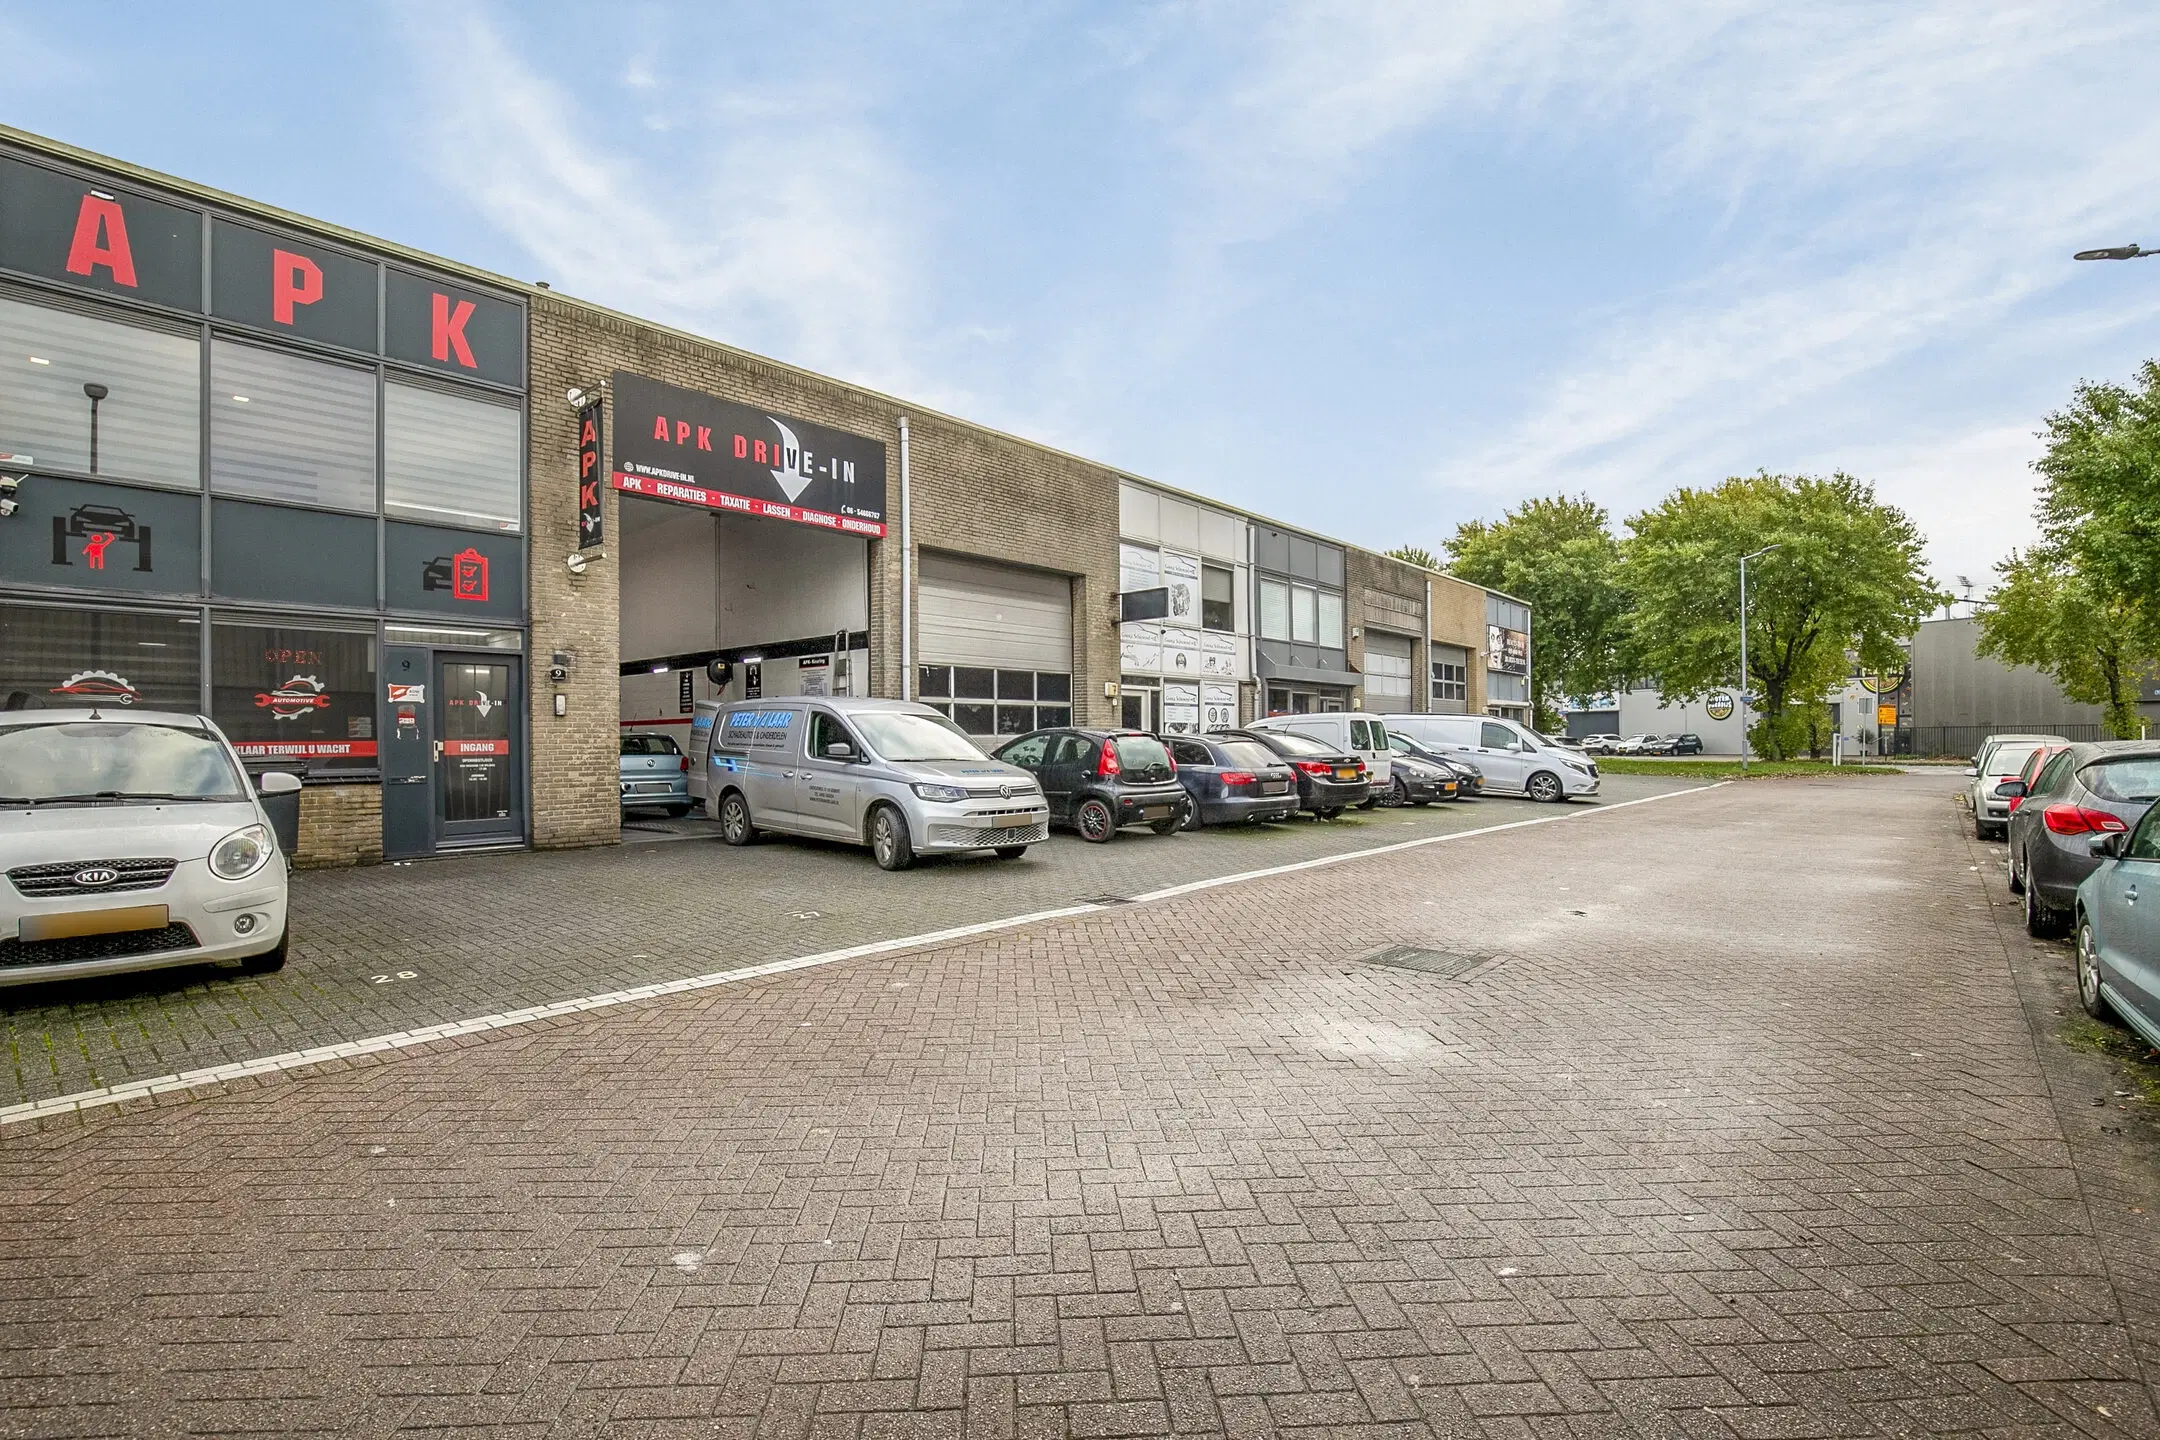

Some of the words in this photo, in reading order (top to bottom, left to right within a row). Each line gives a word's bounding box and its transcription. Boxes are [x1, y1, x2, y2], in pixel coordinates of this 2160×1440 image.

[653, 415, 713, 452] APK
[733, 434, 856, 484] DRIVE-IN
[580, 419, 599, 510] APK
[623, 476, 643, 490] APK
[656, 483, 707, 502] REPARATIES
[720, 494, 751, 511] TAXATIE
[763, 503, 791, 518] LASSEN
[802, 510, 837, 527] DIAGNOSE
[842, 518, 881, 534] ONDERHOUD
[265, 649, 322, 664] OPEN
[555, 669, 562, 677] 9
[730, 712, 755, 728] PETER
[767, 712, 793, 728] LAAR
[235, 745, 265, 755] KLAAR
[267, 744, 307, 755] TERWIJL
[308, 744, 316, 754] U
[317, 744, 351, 754] WACHT
[460, 743, 495, 752] INGANG
[82, 871, 110, 881] KIA
[371, 970, 418, 984] 28
